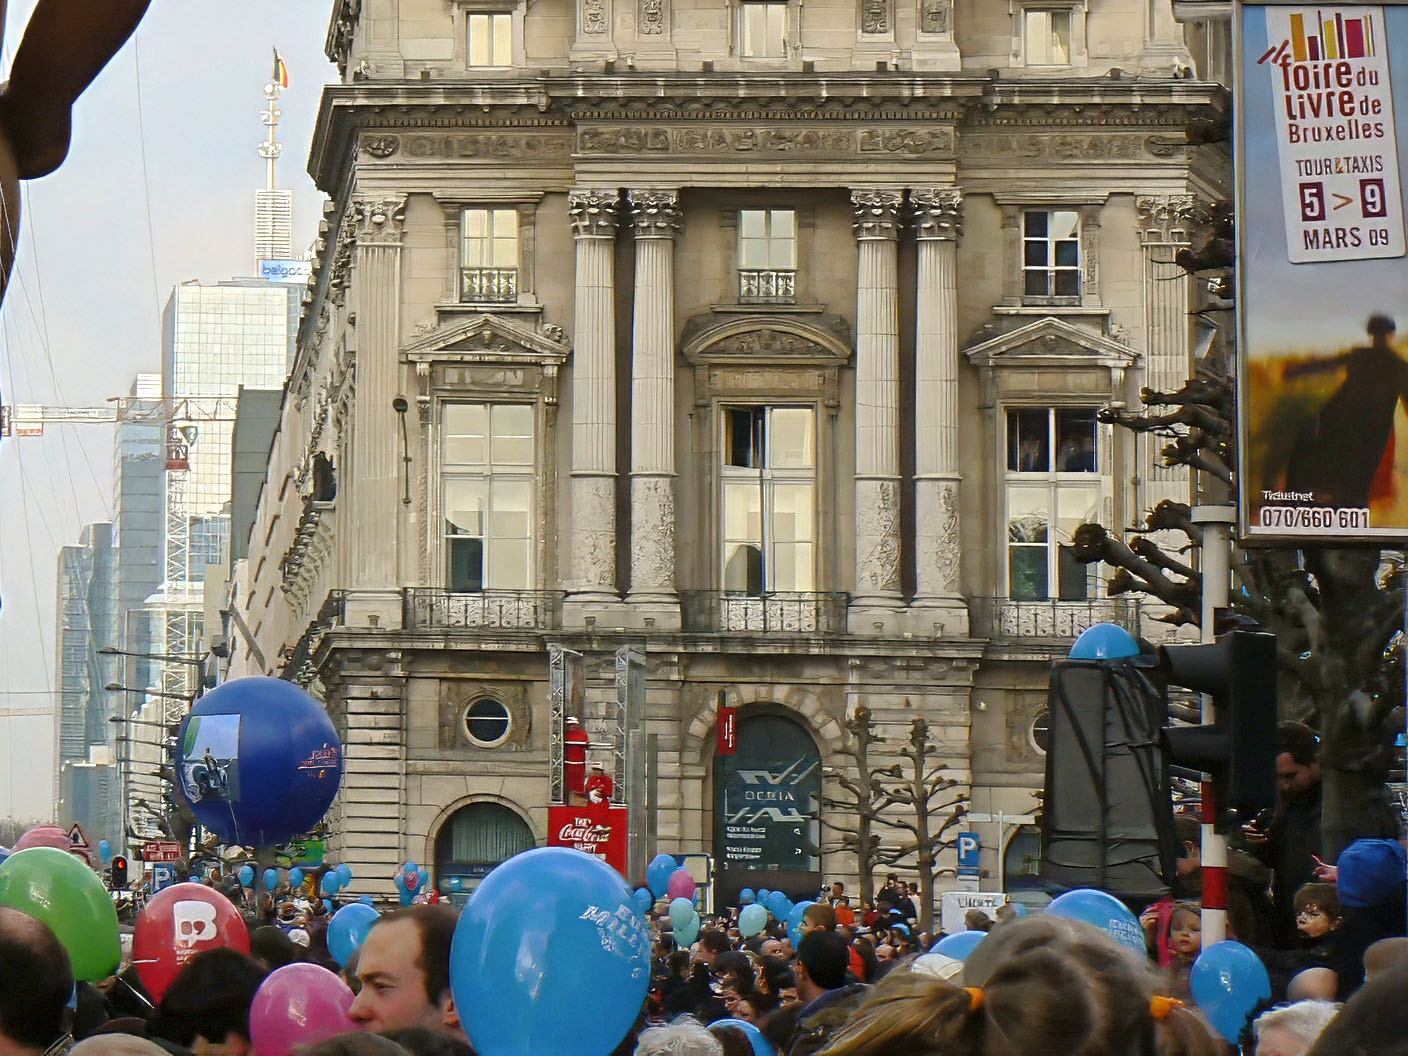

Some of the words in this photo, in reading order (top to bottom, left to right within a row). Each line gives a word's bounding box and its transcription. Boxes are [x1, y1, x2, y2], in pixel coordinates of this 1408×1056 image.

[1279, 53, 1353, 91] foire
[1356, 66, 1379, 86] du
[1359, 95, 1382, 116] de
[1288, 119, 1385, 144] Bruxelles
[1303, 188, 1320, 217] 5
[1364, 183, 1382, 215] 9
[1303, 227, 1362, 250] MARS
[1369, 228, 1390, 246] 09
[1262, 509, 1332, 527] 070/660
[1338, 510, 1368, 528] 601
[960, 837, 976, 859] P
